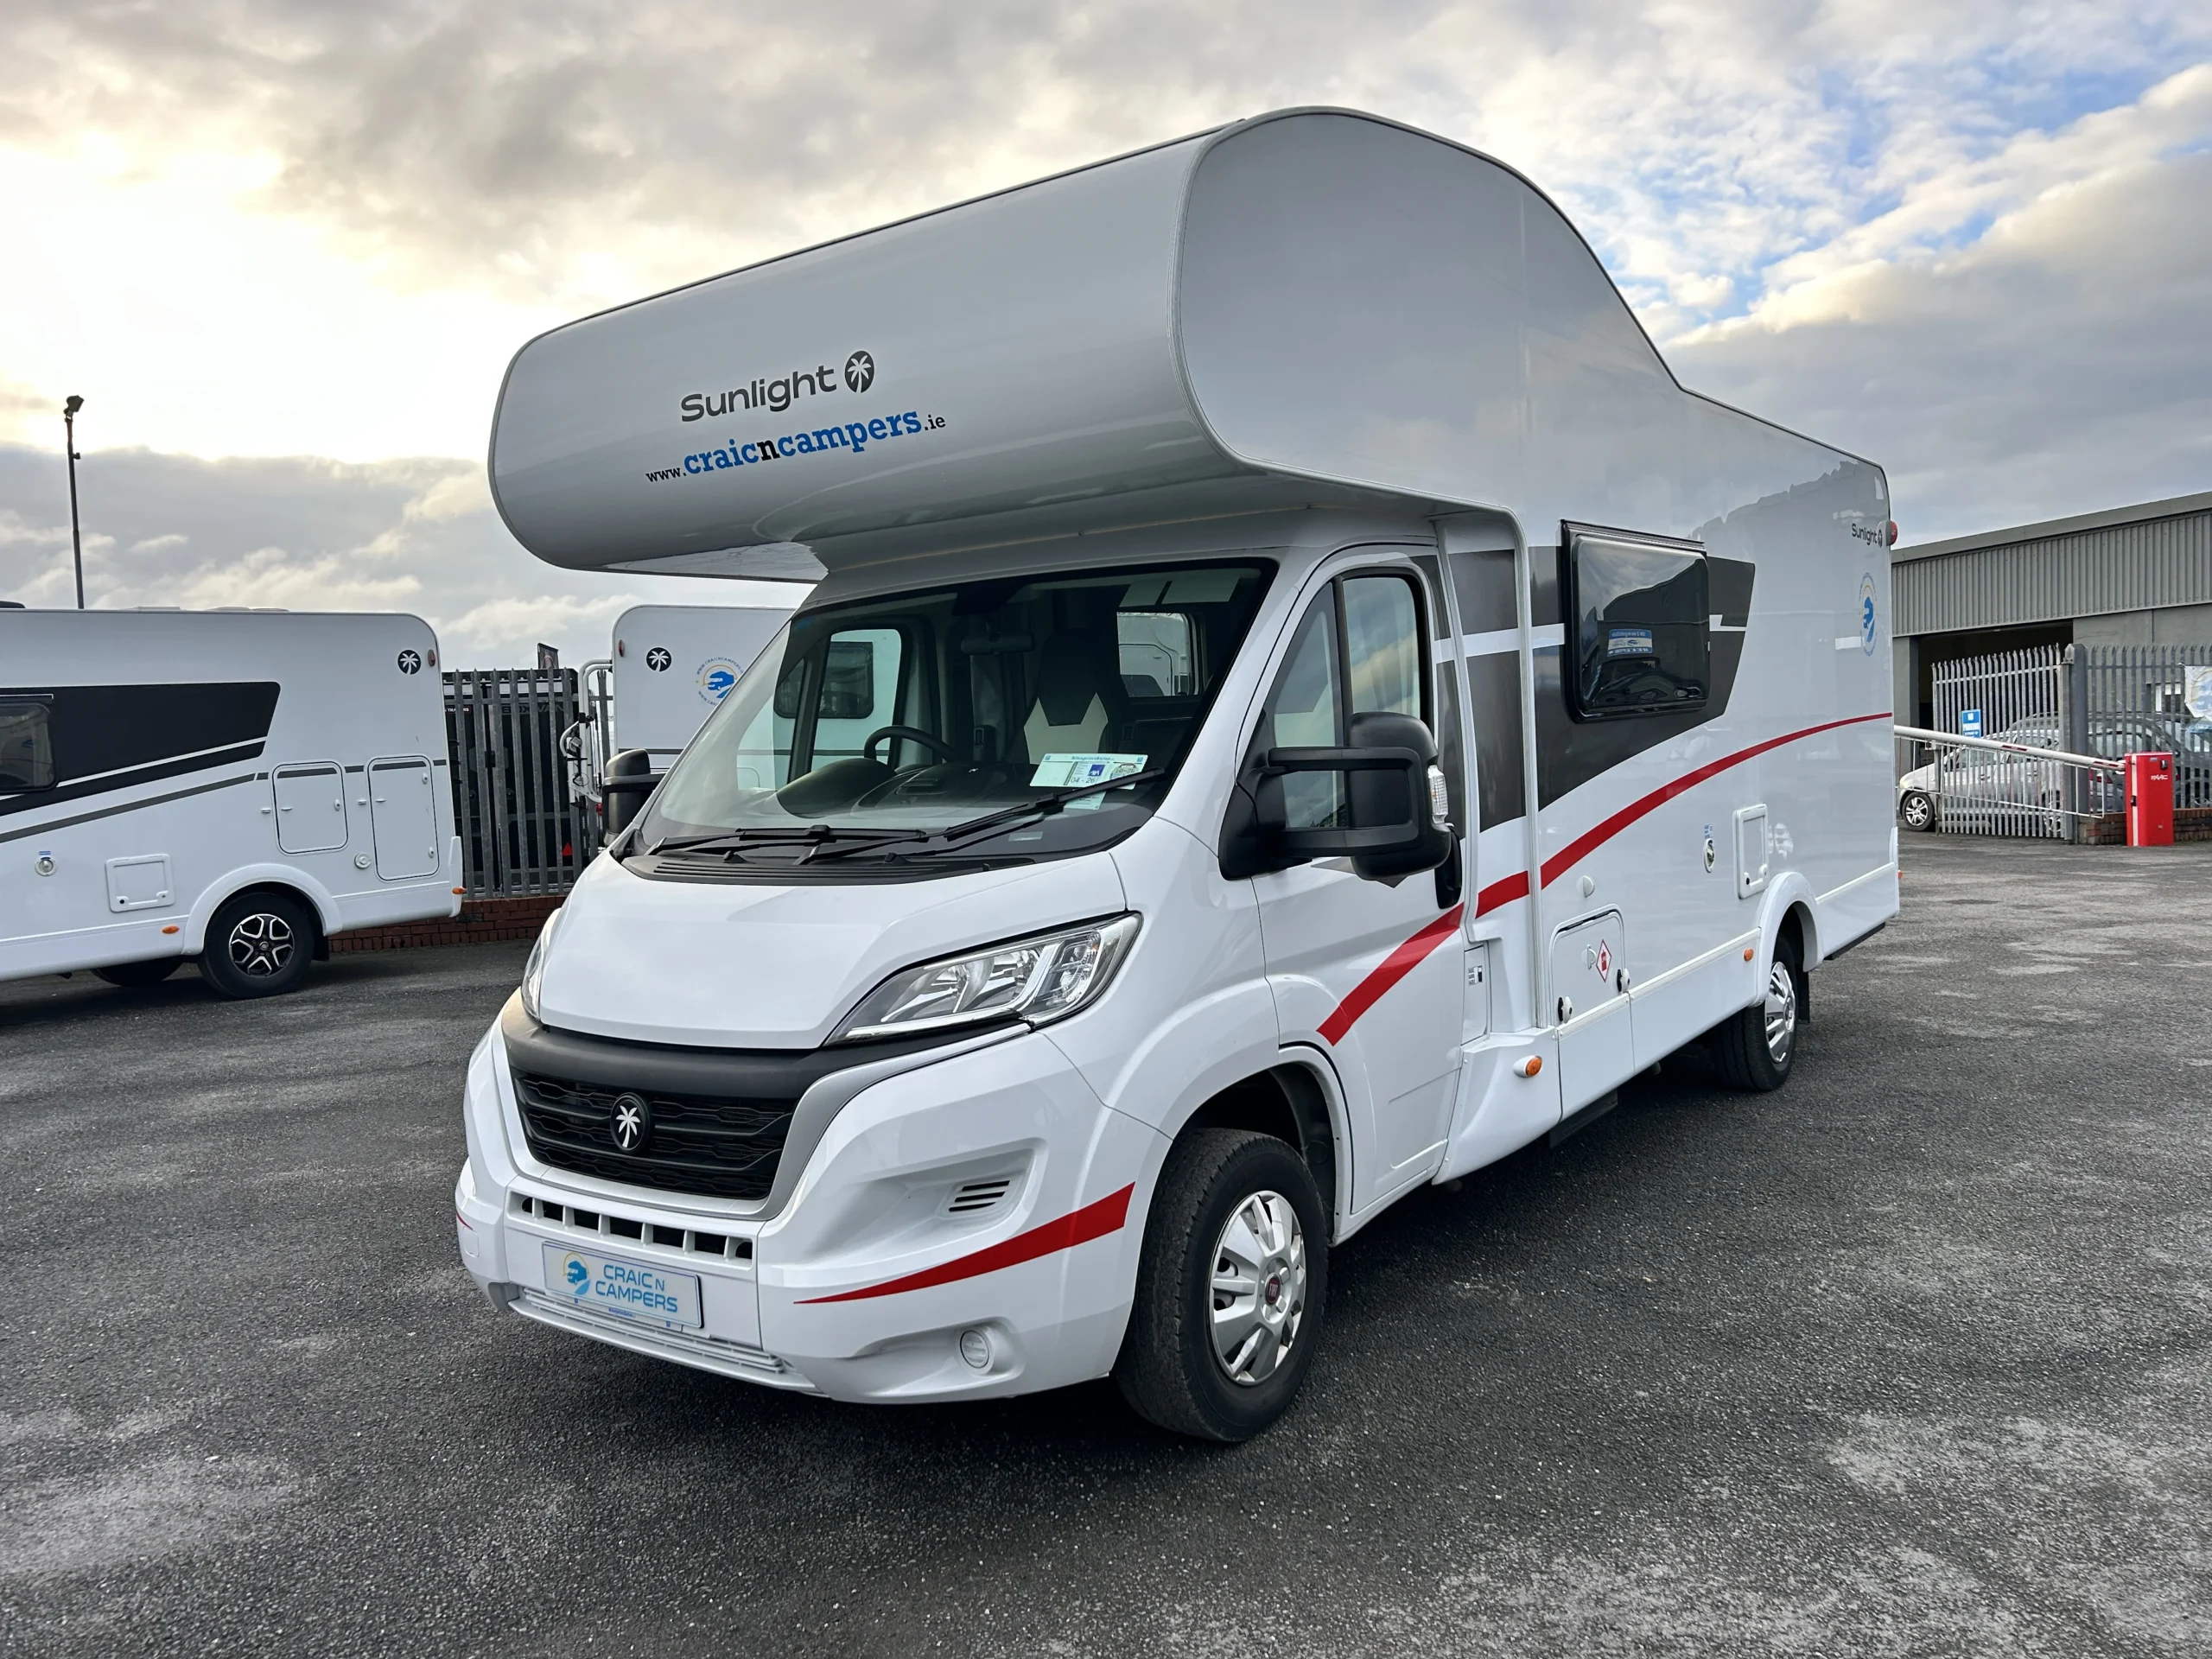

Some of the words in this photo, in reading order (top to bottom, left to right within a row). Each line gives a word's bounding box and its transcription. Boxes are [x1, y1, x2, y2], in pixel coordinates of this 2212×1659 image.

[681, 365, 837, 423] Sunlight
[645, 410, 947, 483] www.craicncampers.ie
[1851, 523, 1878, 546] Sunlight
[603, 1264, 653, 1288] CRAIC
[655, 1279, 665, 1292] N
[594, 1281, 678, 1313] CAMPERS
